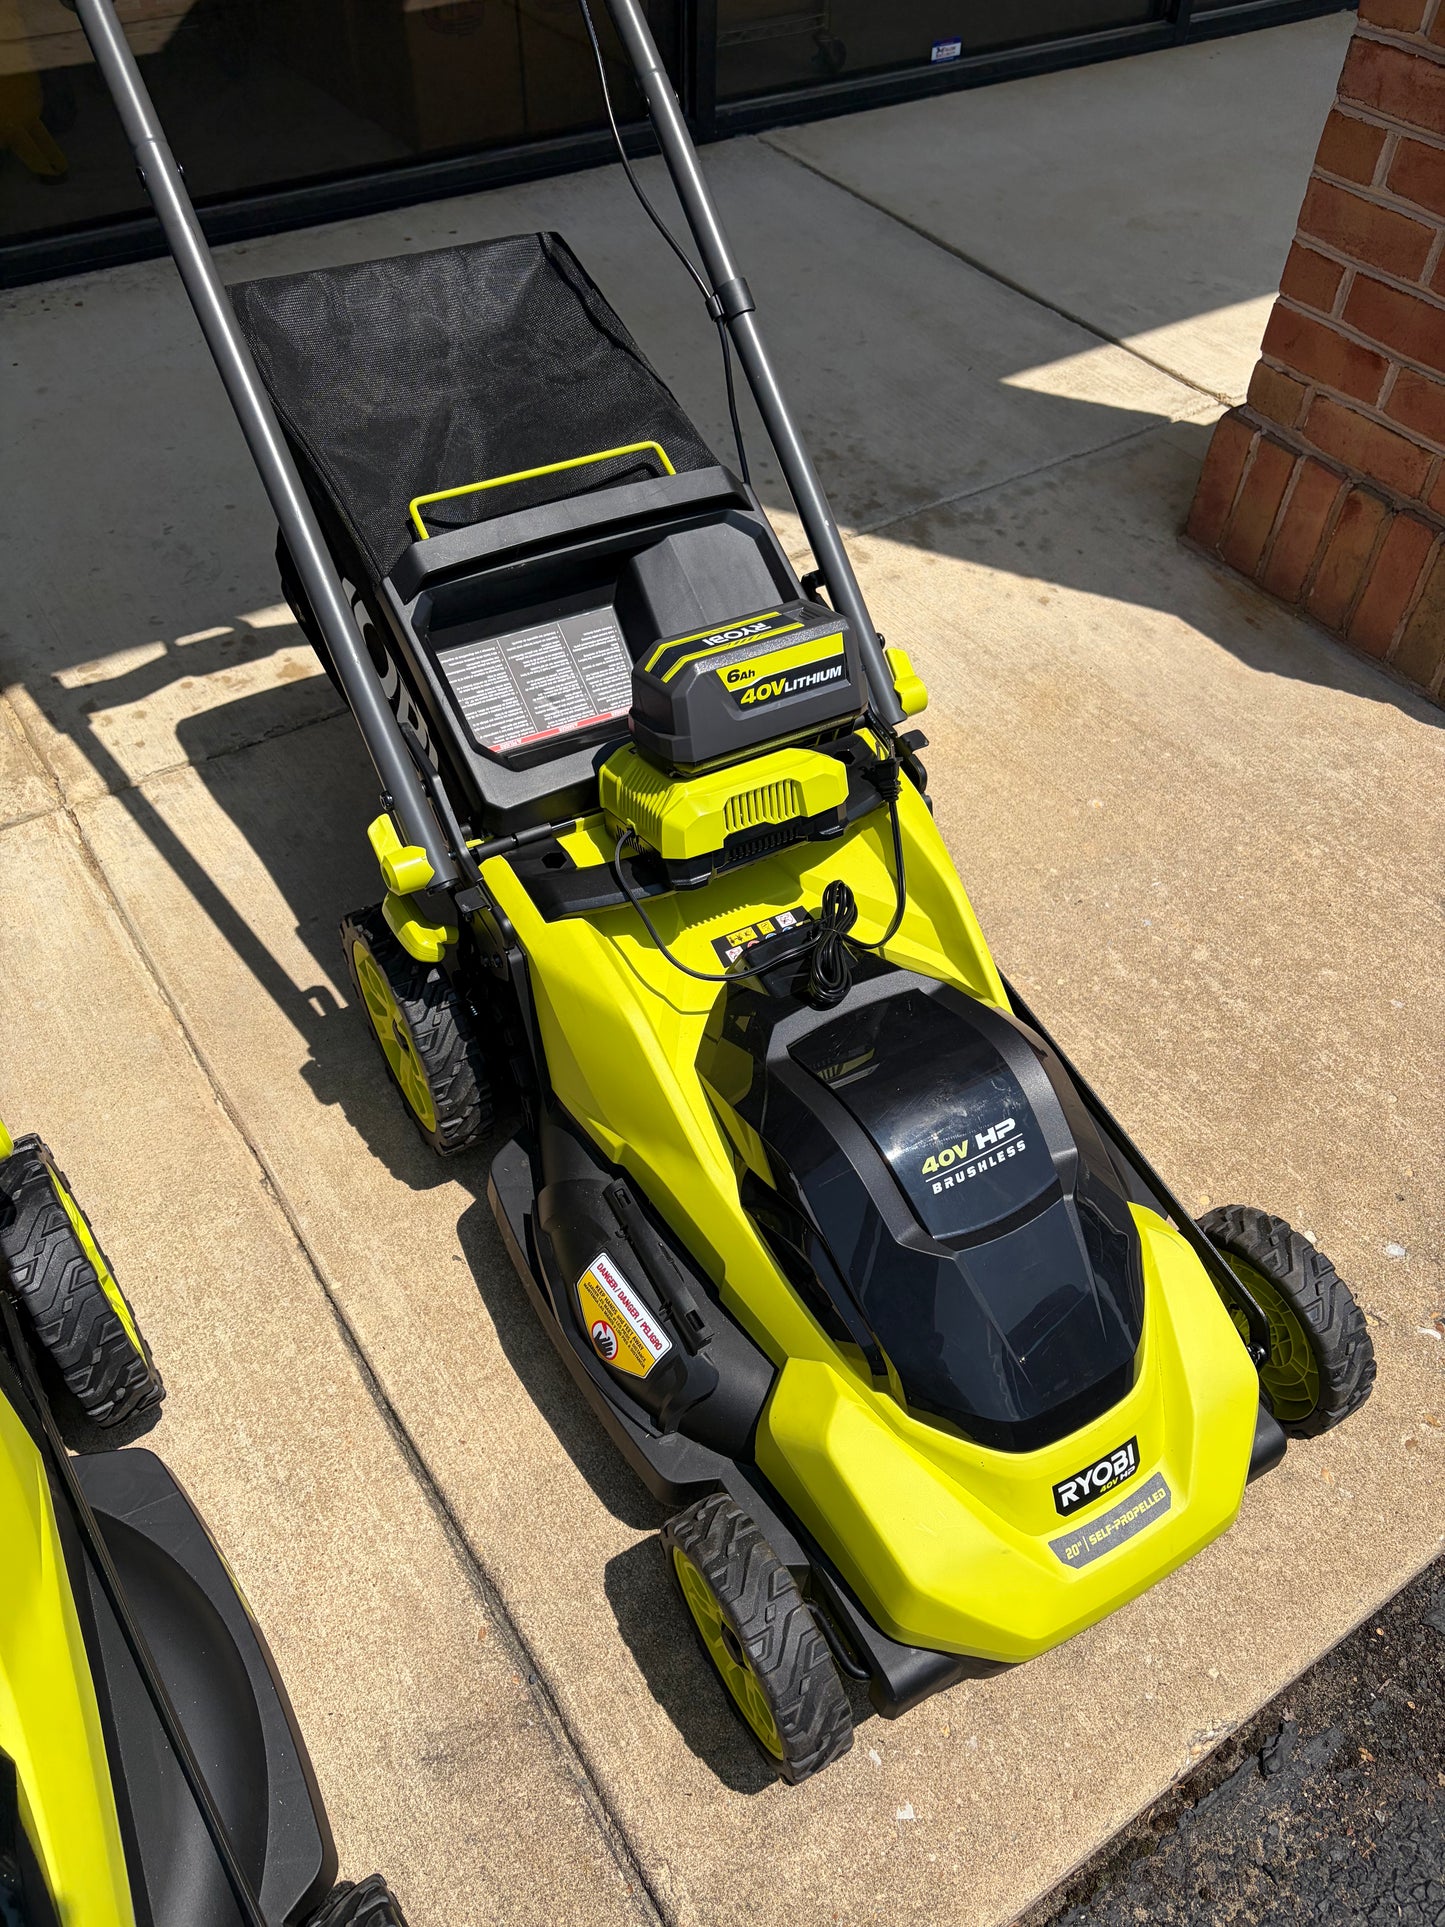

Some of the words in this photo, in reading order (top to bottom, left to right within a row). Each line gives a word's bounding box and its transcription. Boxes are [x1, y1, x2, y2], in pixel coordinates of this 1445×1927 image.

[702, 622, 772, 646] RYOBI
[726, 668, 755, 683] 6Ah
[921, 1140, 968, 1175] 40V
[975, 1117, 1016, 1150] HP
[931, 1140, 1026, 1195] BRUSHLESS
[595, 1285, 606, 1298] KEEP
[604, 1297, 619, 1315] HANDS
[616, 1314, 625, 1325] and
[623, 1323, 634, 1336] FEET
[632, 1336, 645, 1351] AWAY
[596, 1263, 619, 1290] DANGER
[617, 1291, 641, 1320] DANGER
[639, 1321, 664, 1351] PELIGRO
[1058, 1443, 1135, 1508] RYOBI
[1100, 1477, 1119, 1493] 40V
[1120, 1466, 1136, 1481] HP
[1088, 1487, 1167, 1546] SELF-PROPELLED
